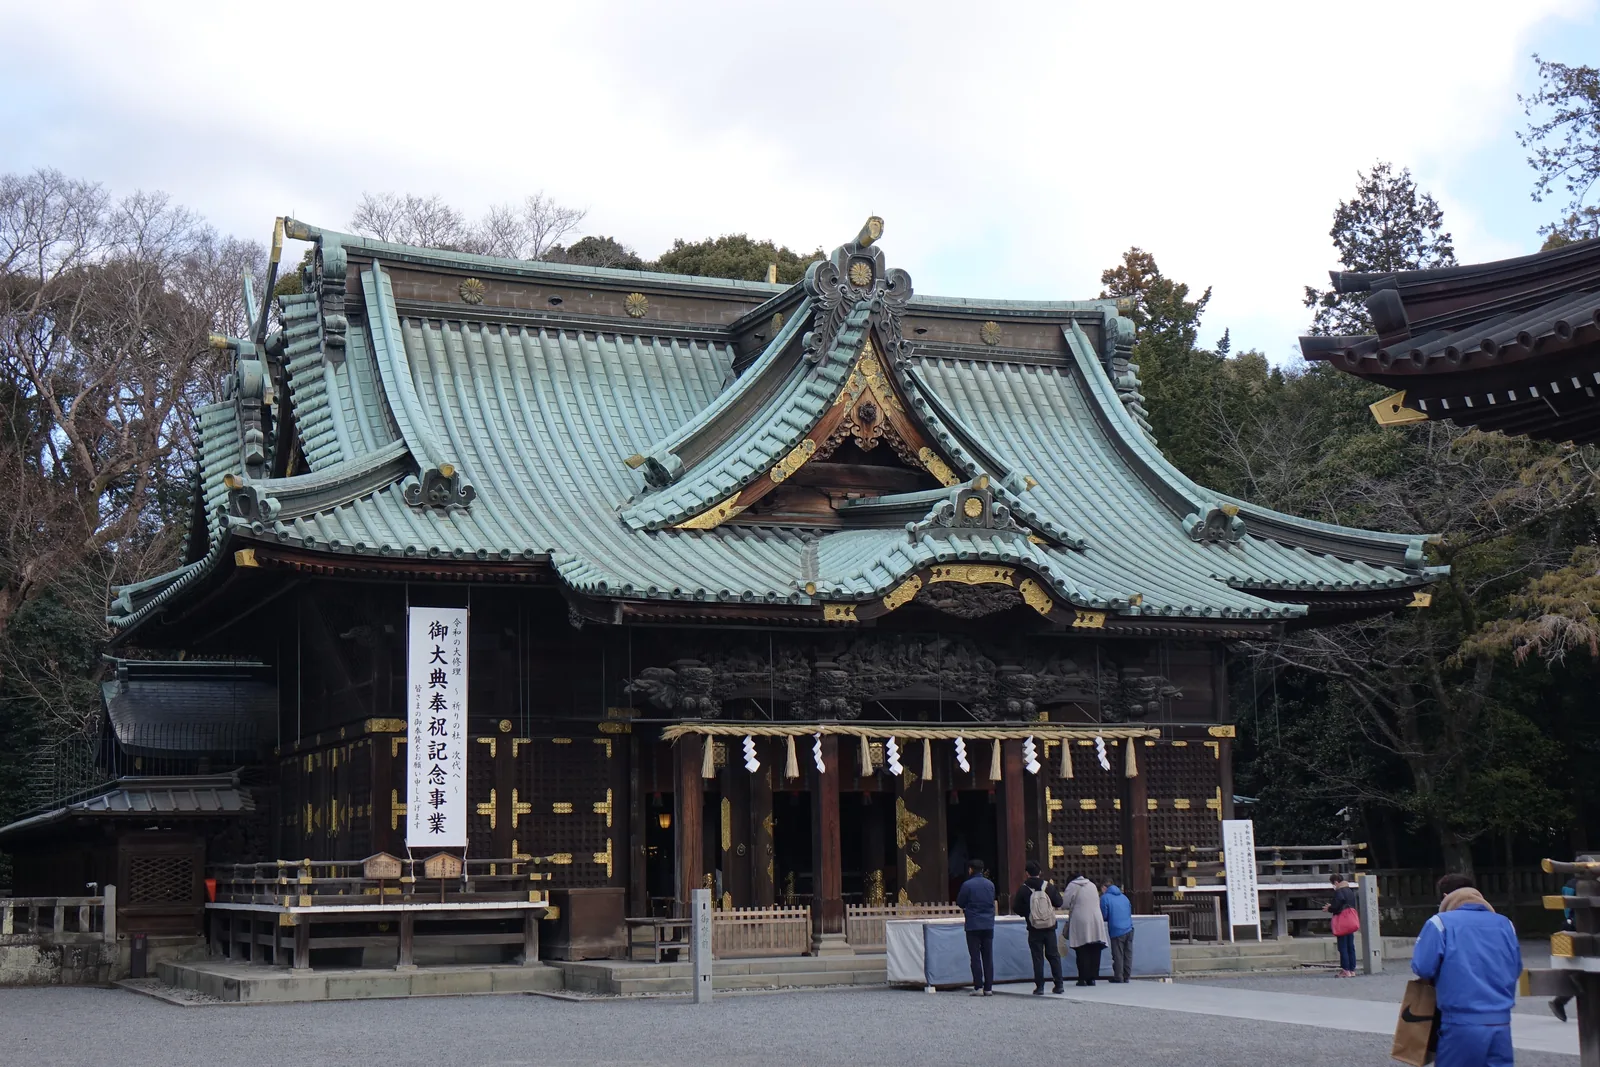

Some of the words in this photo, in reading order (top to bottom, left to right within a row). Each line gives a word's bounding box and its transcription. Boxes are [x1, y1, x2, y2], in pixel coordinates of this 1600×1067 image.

[427, 620, 448, 835] 御大典奉祝記念事業
